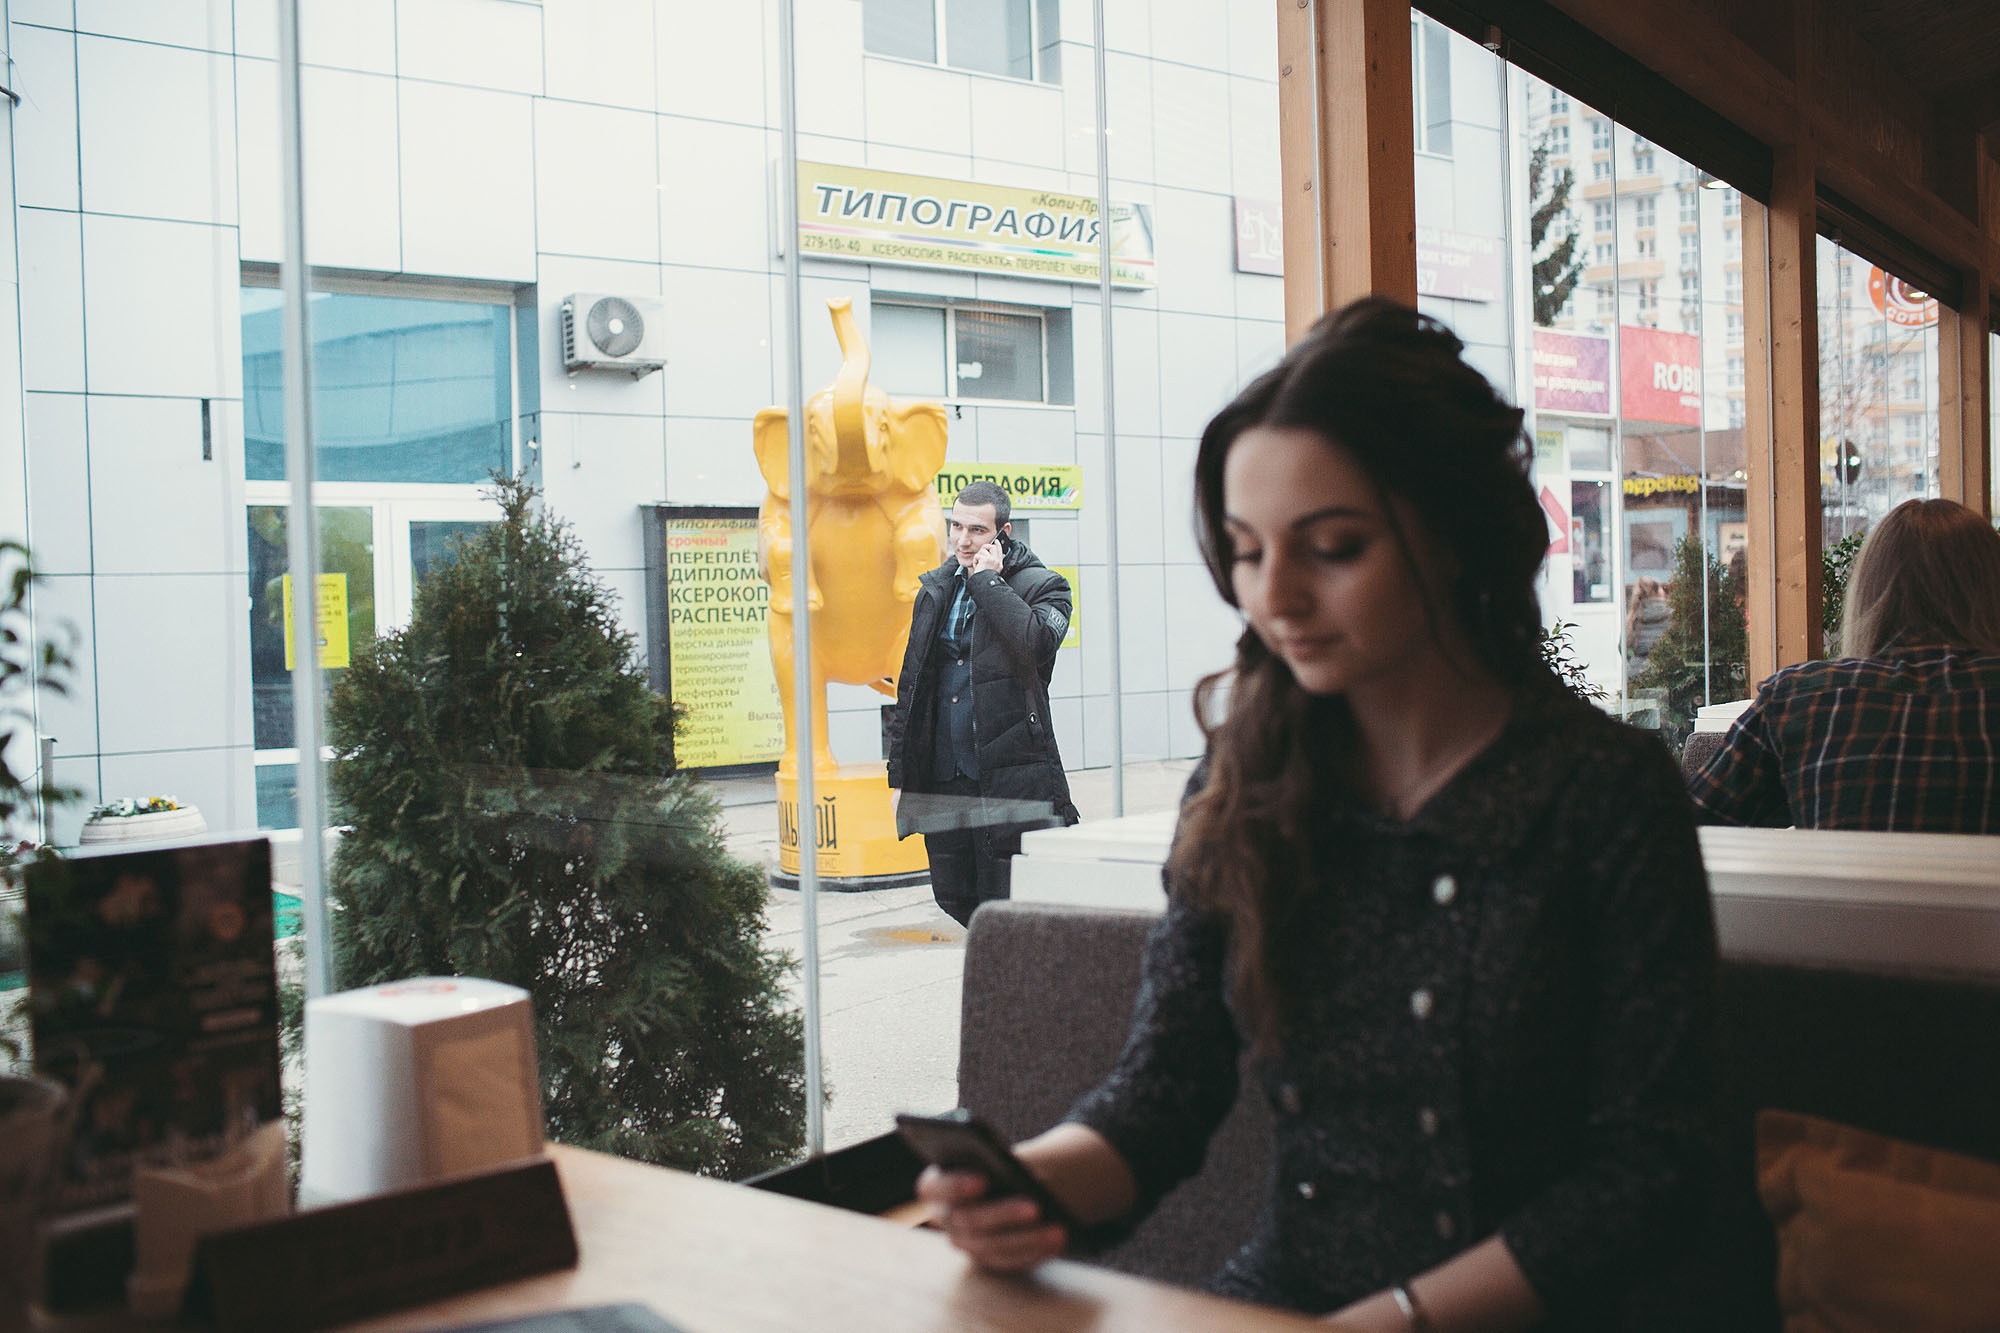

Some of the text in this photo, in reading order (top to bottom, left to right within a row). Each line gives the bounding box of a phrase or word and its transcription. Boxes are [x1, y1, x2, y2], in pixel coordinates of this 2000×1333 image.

[815, 186, 1101, 243] ТИПОГРАФИЯ
[872, 243, 943, 261] КСЕРОКОПИЯ
[947, 250, 1013, 268] РАСПЕЧАТКА
[667, 536, 728, 550] срочный
[727, 625, 760, 635] печать
[675, 688, 740, 700] рефераты
